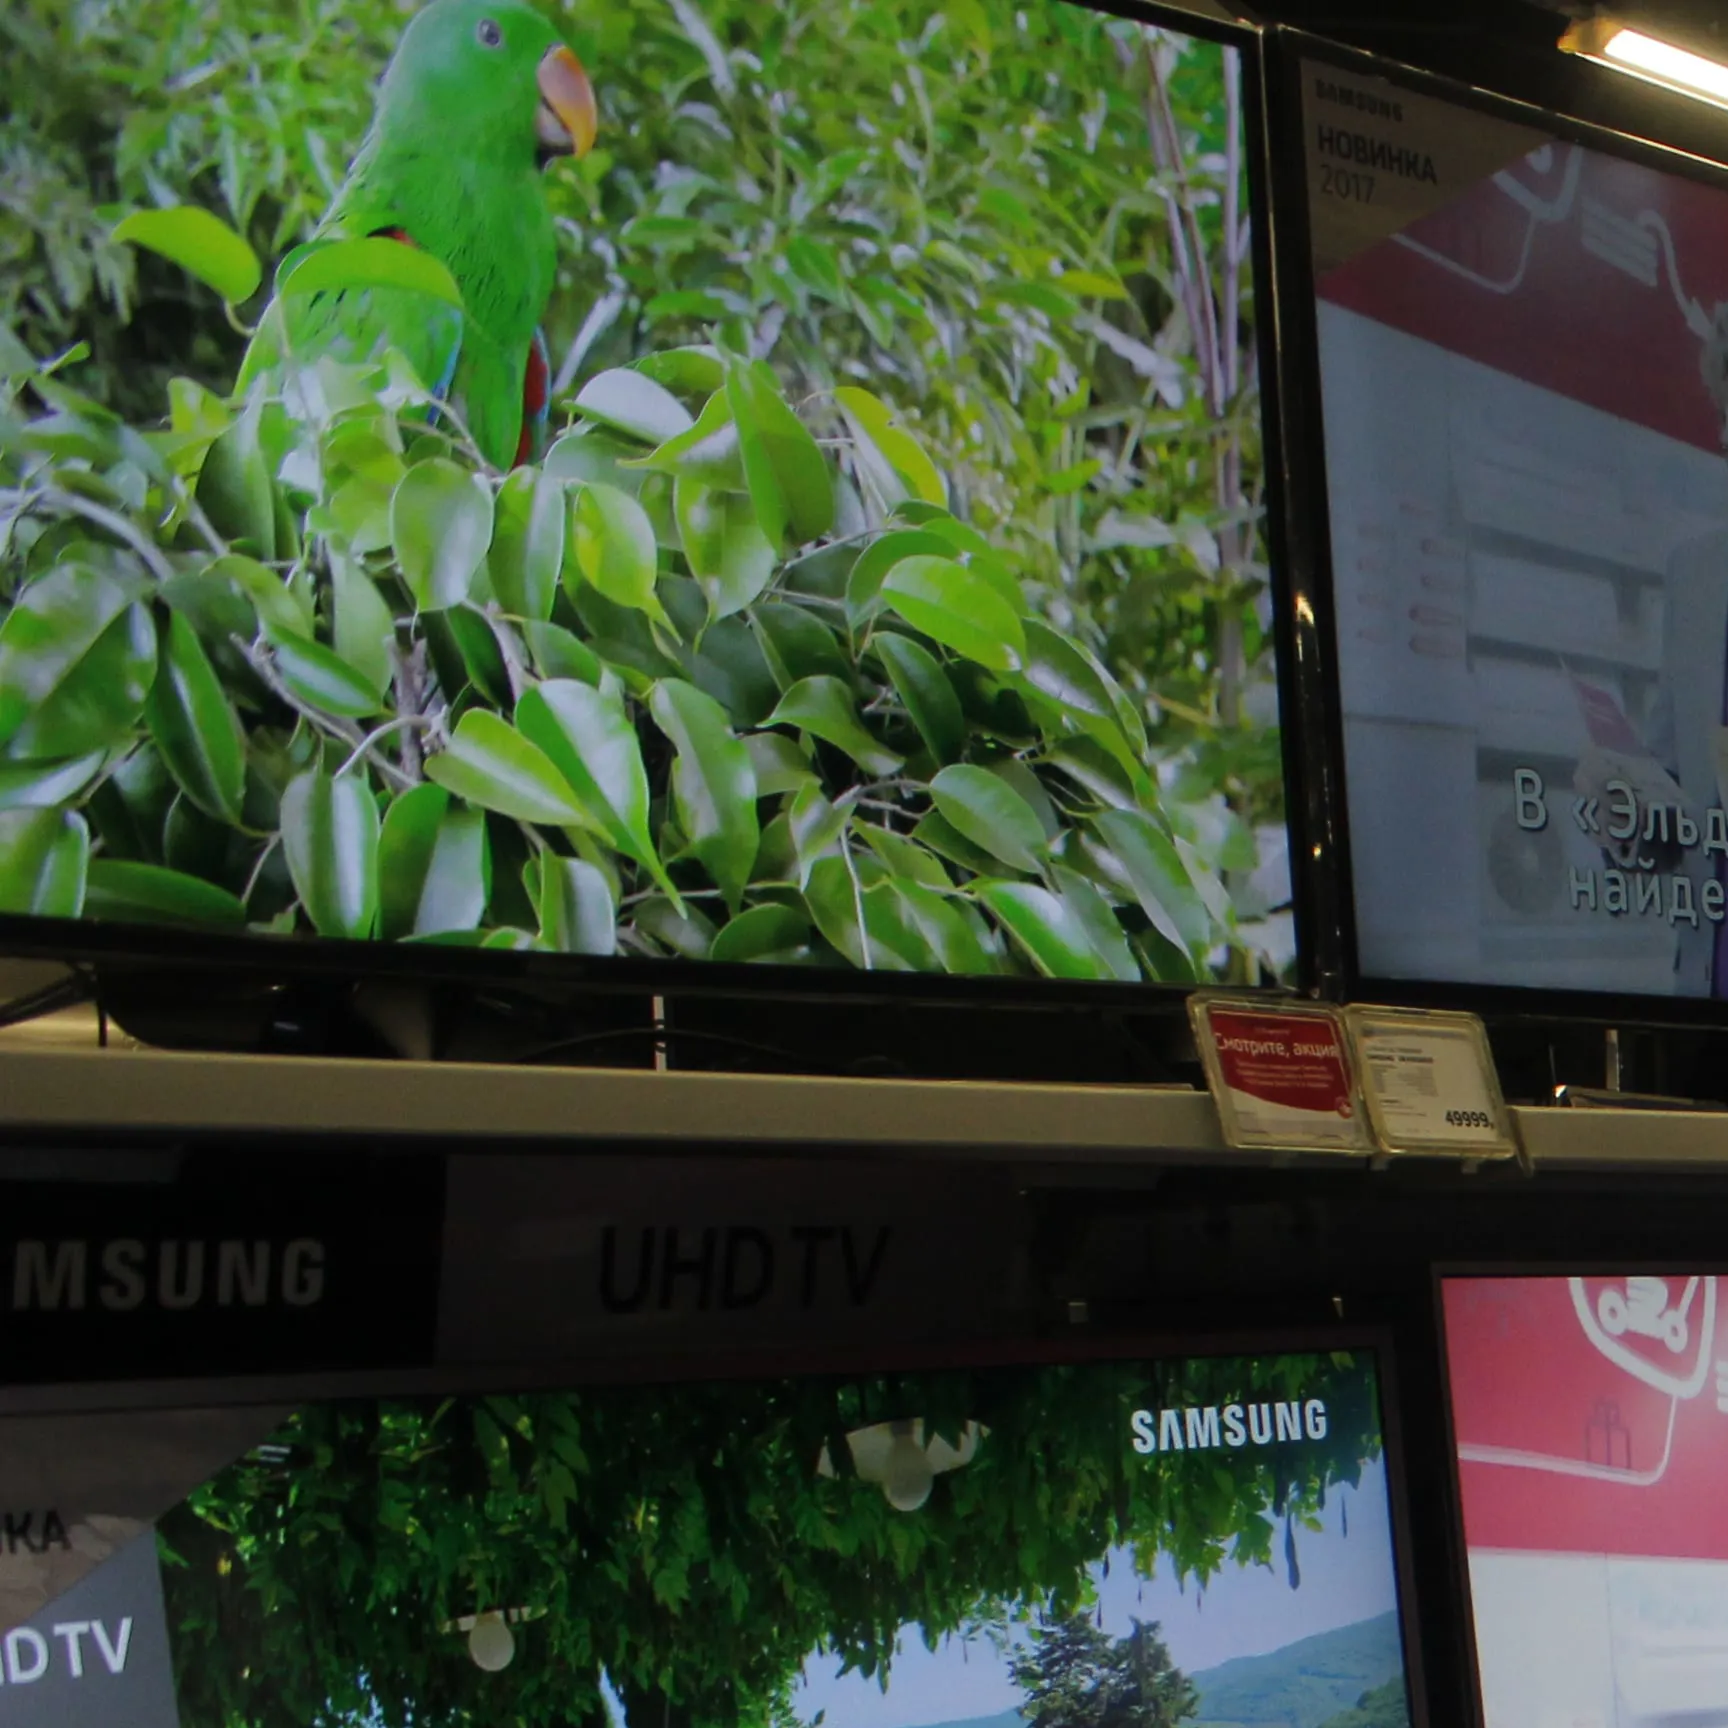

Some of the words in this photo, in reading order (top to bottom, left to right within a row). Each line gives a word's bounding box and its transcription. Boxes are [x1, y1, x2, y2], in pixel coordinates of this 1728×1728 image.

[1318, 124, 1438, 186] НОВИНКА
[1320, 163, 1376, 204] 2017
[1512, 767, 1548, 831] В
[598, 1224, 776, 1316] UHD
[790, 1224, 892, 1309] TV
[1130, 1397, 1328, 1455] SAMSUNG
[0, 1509, 73, 1556] КА
[53, 1616, 133, 1679] TV
